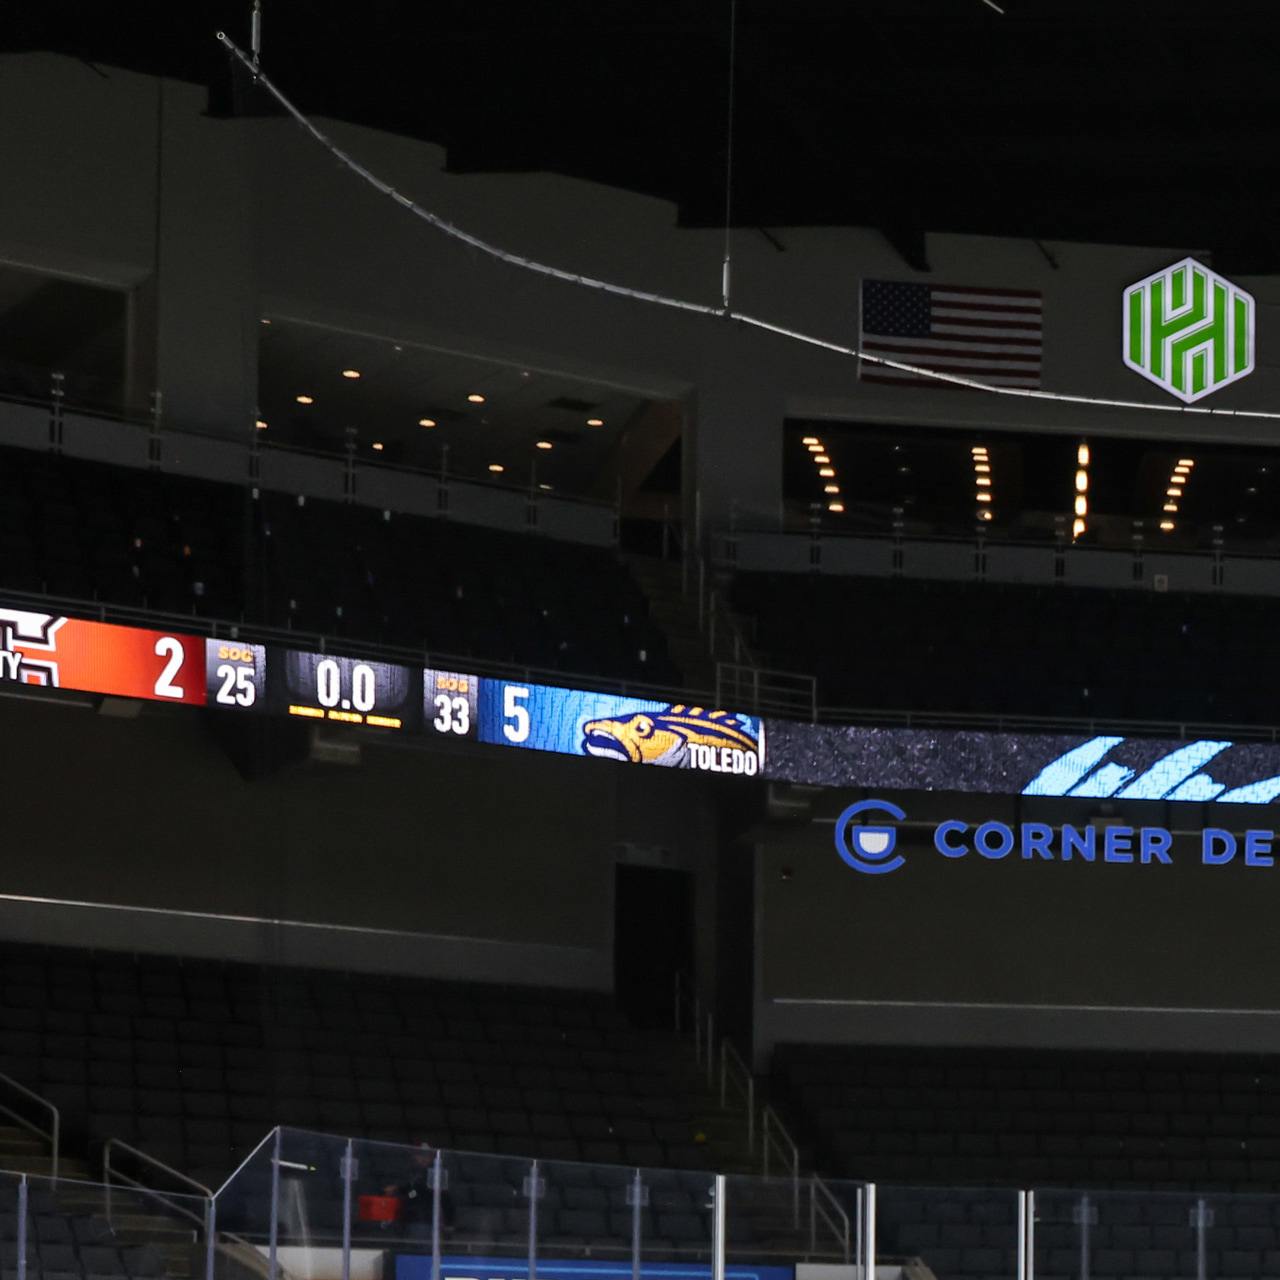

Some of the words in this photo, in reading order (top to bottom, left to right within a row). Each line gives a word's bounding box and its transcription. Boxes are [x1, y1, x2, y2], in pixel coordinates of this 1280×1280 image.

[0, 650, 23, 681] TY
[153, 635, 185, 699] 2
[215, 664, 256, 707] 25
[316, 659, 376, 713] 0.0
[433, 694, 470, 736] 33
[503, 684, 531, 744] 5
[687, 740, 759, 777] TOLEDO
[933, 818, 1174, 867] CORNER
